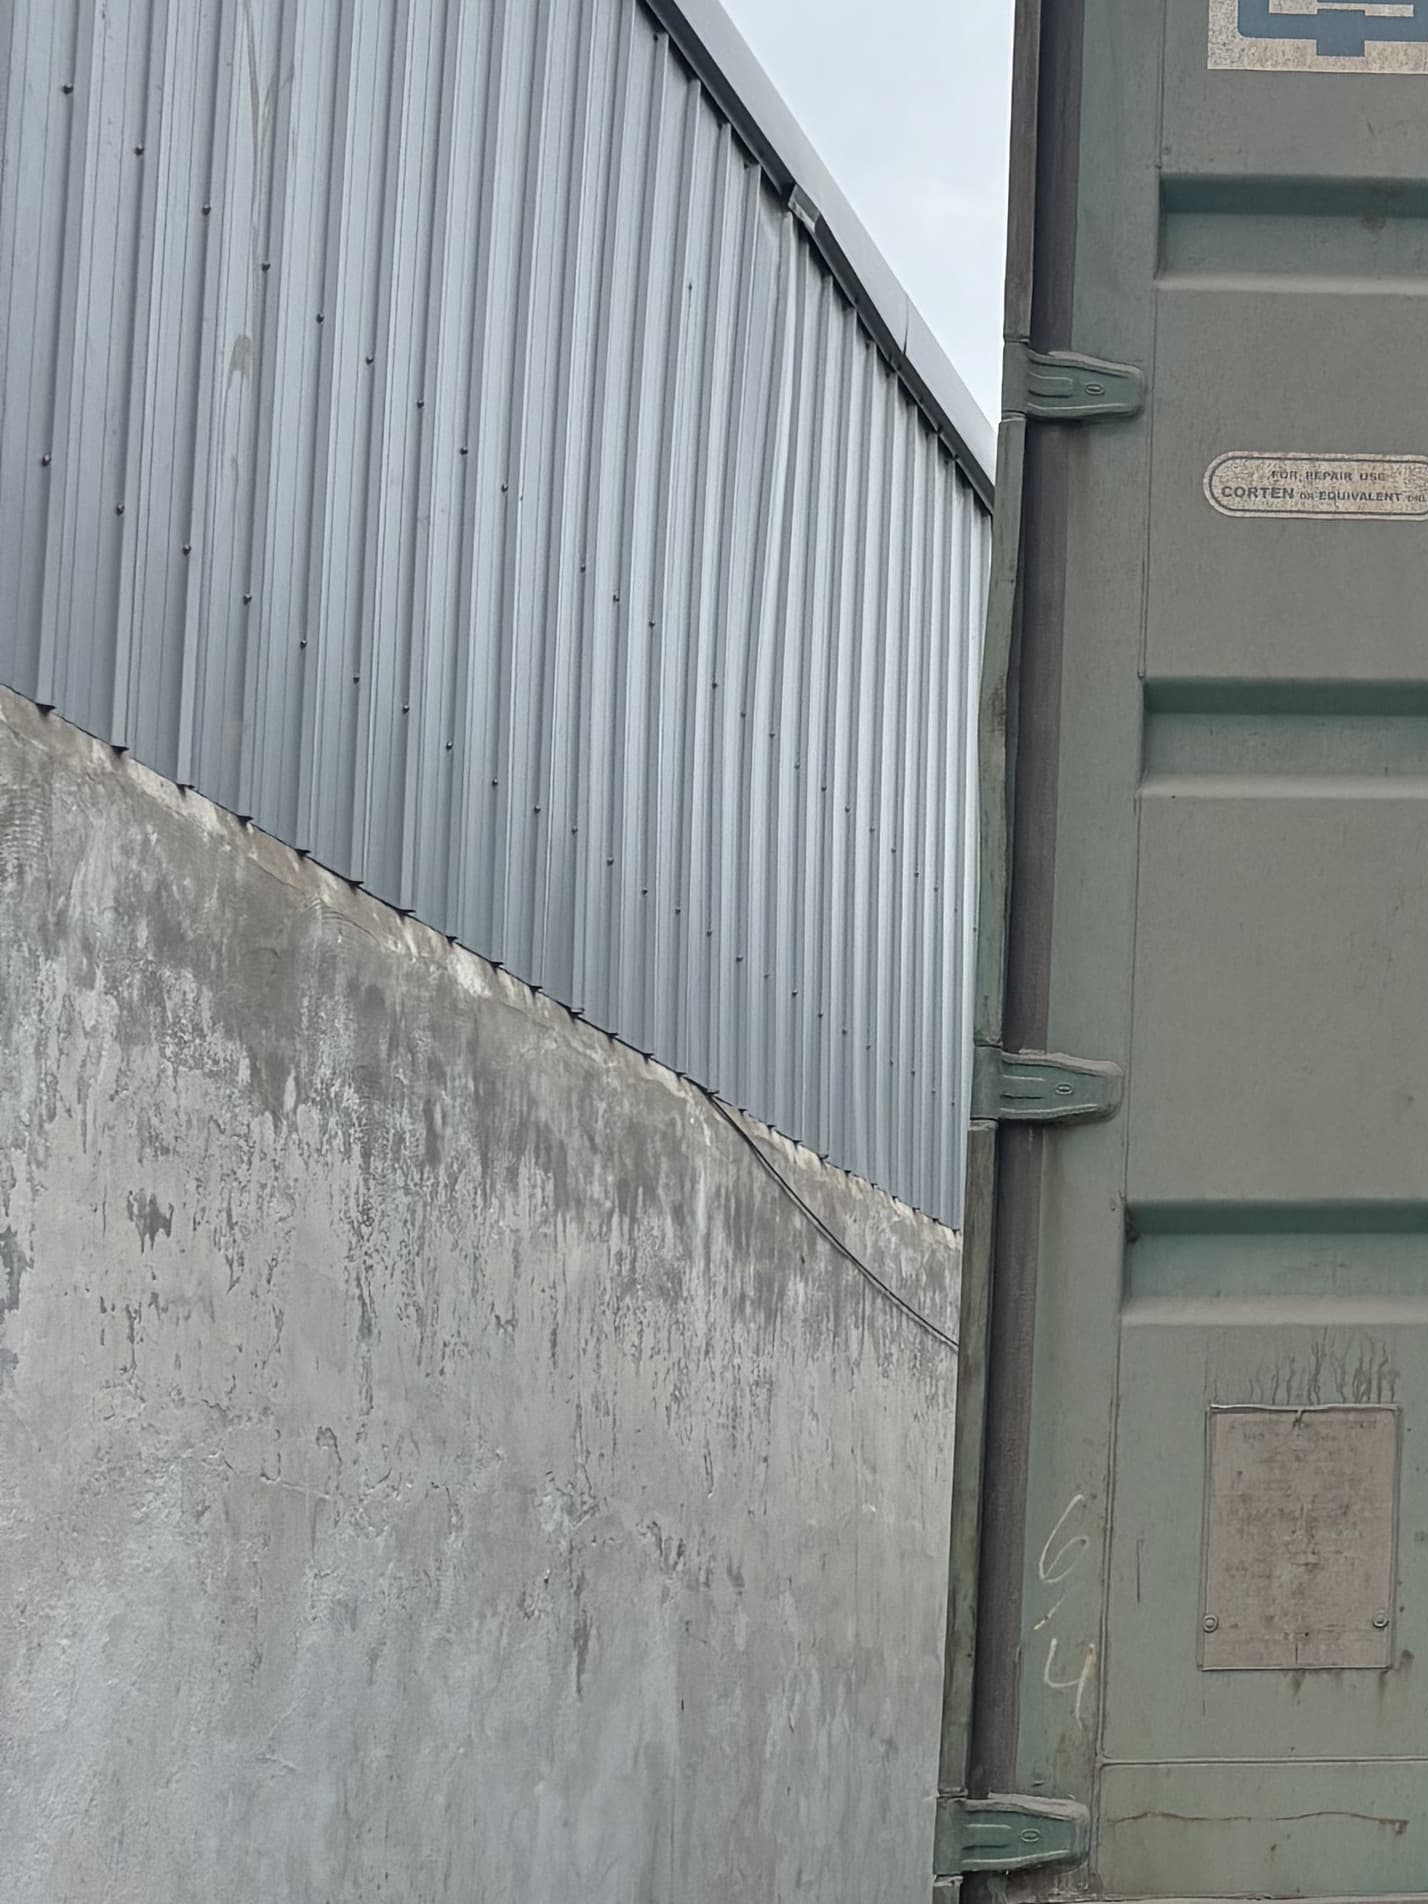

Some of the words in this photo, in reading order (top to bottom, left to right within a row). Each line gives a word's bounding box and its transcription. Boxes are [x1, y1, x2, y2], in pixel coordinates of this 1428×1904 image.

[1270, 470, 1298, 481] FOR
[1305, 471, 1353, 482] REPAIR
[1221, 486, 1294, 500] CORTEN
[1318, 491, 1402, 502] EQUIVALENT
